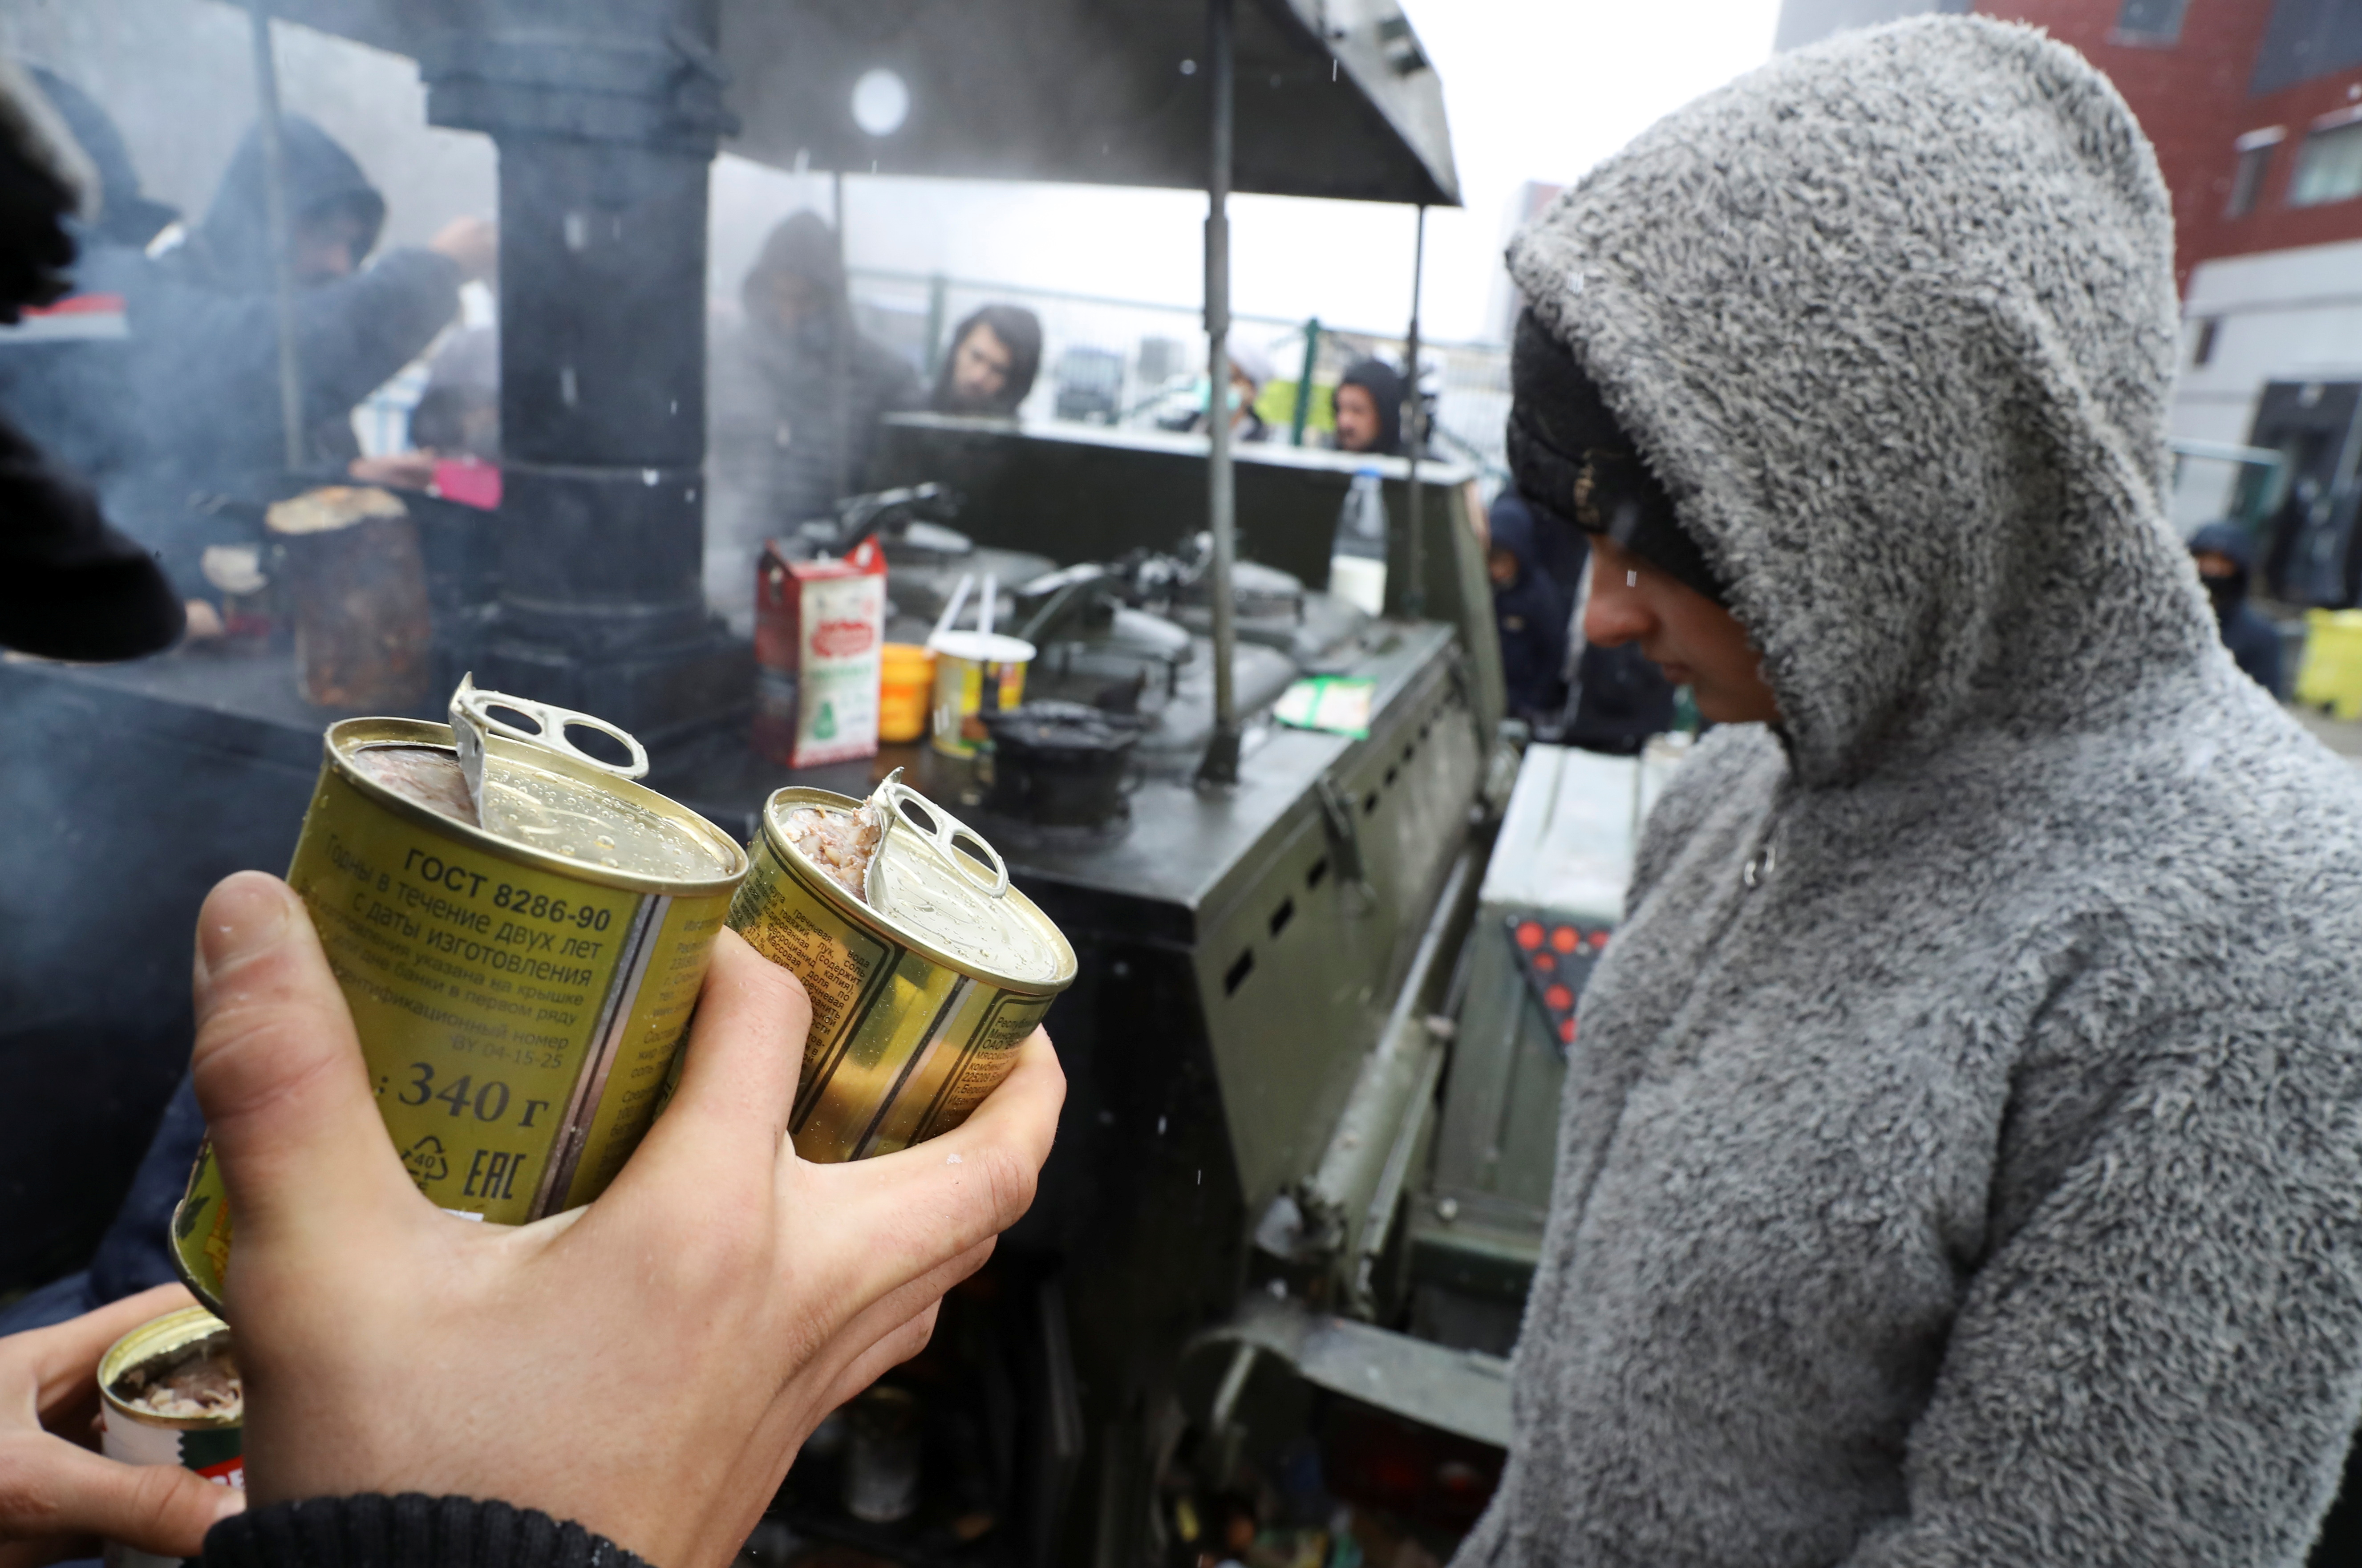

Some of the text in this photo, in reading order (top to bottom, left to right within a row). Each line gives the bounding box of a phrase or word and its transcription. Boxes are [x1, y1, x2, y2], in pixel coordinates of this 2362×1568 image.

[326, 834, 604, 959] Годны в течение двух лет
[405, 848, 611, 932] ГОСТ 8286-90
[366, 901, 421, 940] даты
[426, 928, 592, 987] изготовления
[766, 932, 802, 968] Массовая
[806, 970, 829, 989] доля
[837, 990, 850, 1001] по
[767, 922, 817, 969] ферроцианид
[823, 969, 854, 995] калия),
[780, 908, 810, 940] говяжий,
[818, 941, 834, 959] лук,
[843, 959, 866, 978] соль
[793, 909, 833, 946] гречневая,
[847, 950, 870, 968] вода
[815, 952, 862, 985] (содержит
[394, 961, 445, 993] банки
[449, 985, 460, 998] в
[465, 990, 533, 1015] первом
[536, 1008, 578, 1027] ряду
[413, 953, 486, 986] указана
[490, 978, 512, 993] на
[517, 985, 584, 1006] крышке
[771, 952, 794, 972] крупа
[800, 976, 845, 1010] гречневая
[513, 1031, 569, 1051] номер
[982, 1039, 1004, 1050] ОАО
[398, 1062, 510, 1122] 340
[518, 1099, 550, 1127] г
